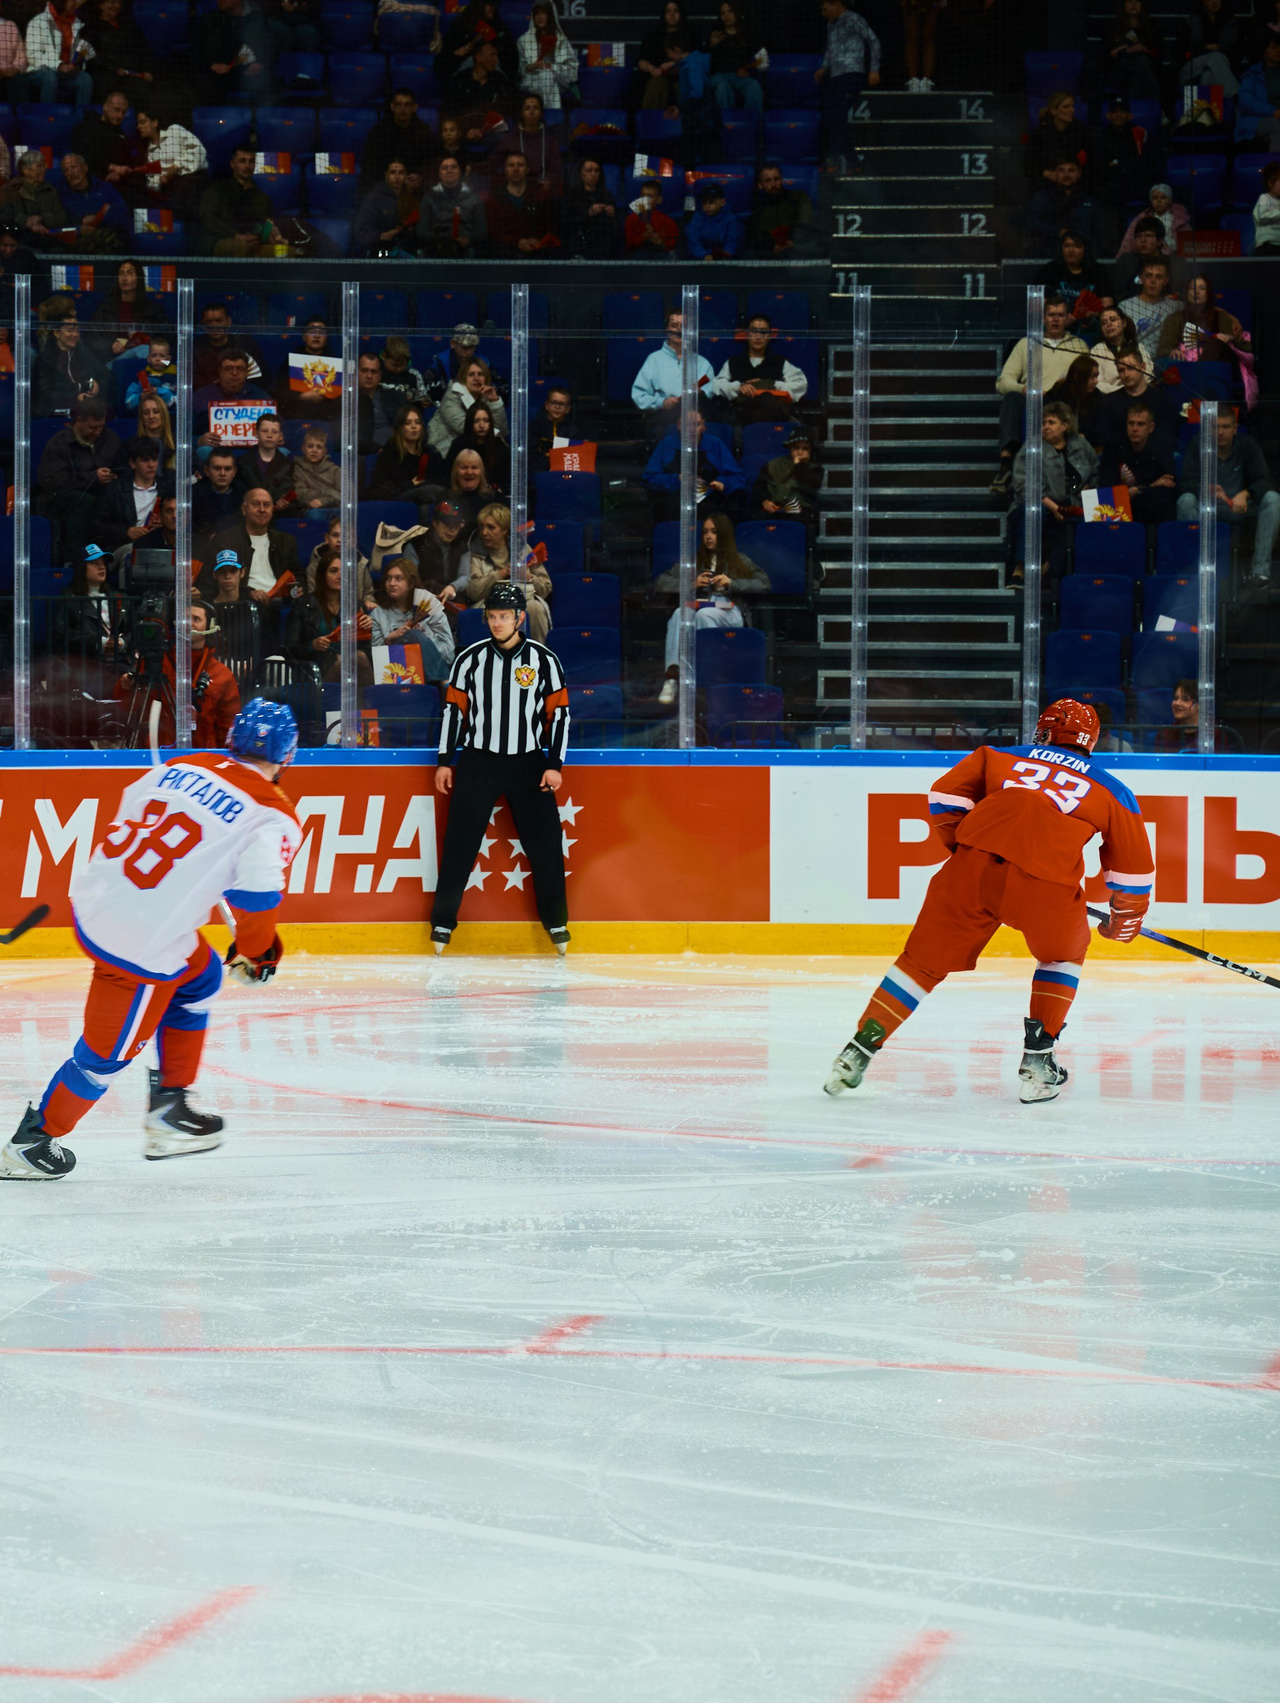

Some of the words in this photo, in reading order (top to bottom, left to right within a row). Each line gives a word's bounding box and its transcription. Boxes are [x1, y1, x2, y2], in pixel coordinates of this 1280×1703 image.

[958, 98, 985, 122] 14
[960, 153, 989, 175] 13
[835, 213, 863, 236] 12
[959, 213, 988, 236] 12
[962, 273, 986, 298] 11
[1076, 731, 1091, 746] 33
[1028, 748, 1091, 774] KORZIN
[1002, 761, 1092, 815] 33
[867, 793, 1280, 905] РЛЬ
[1207, 952, 1268, 982] CCM
